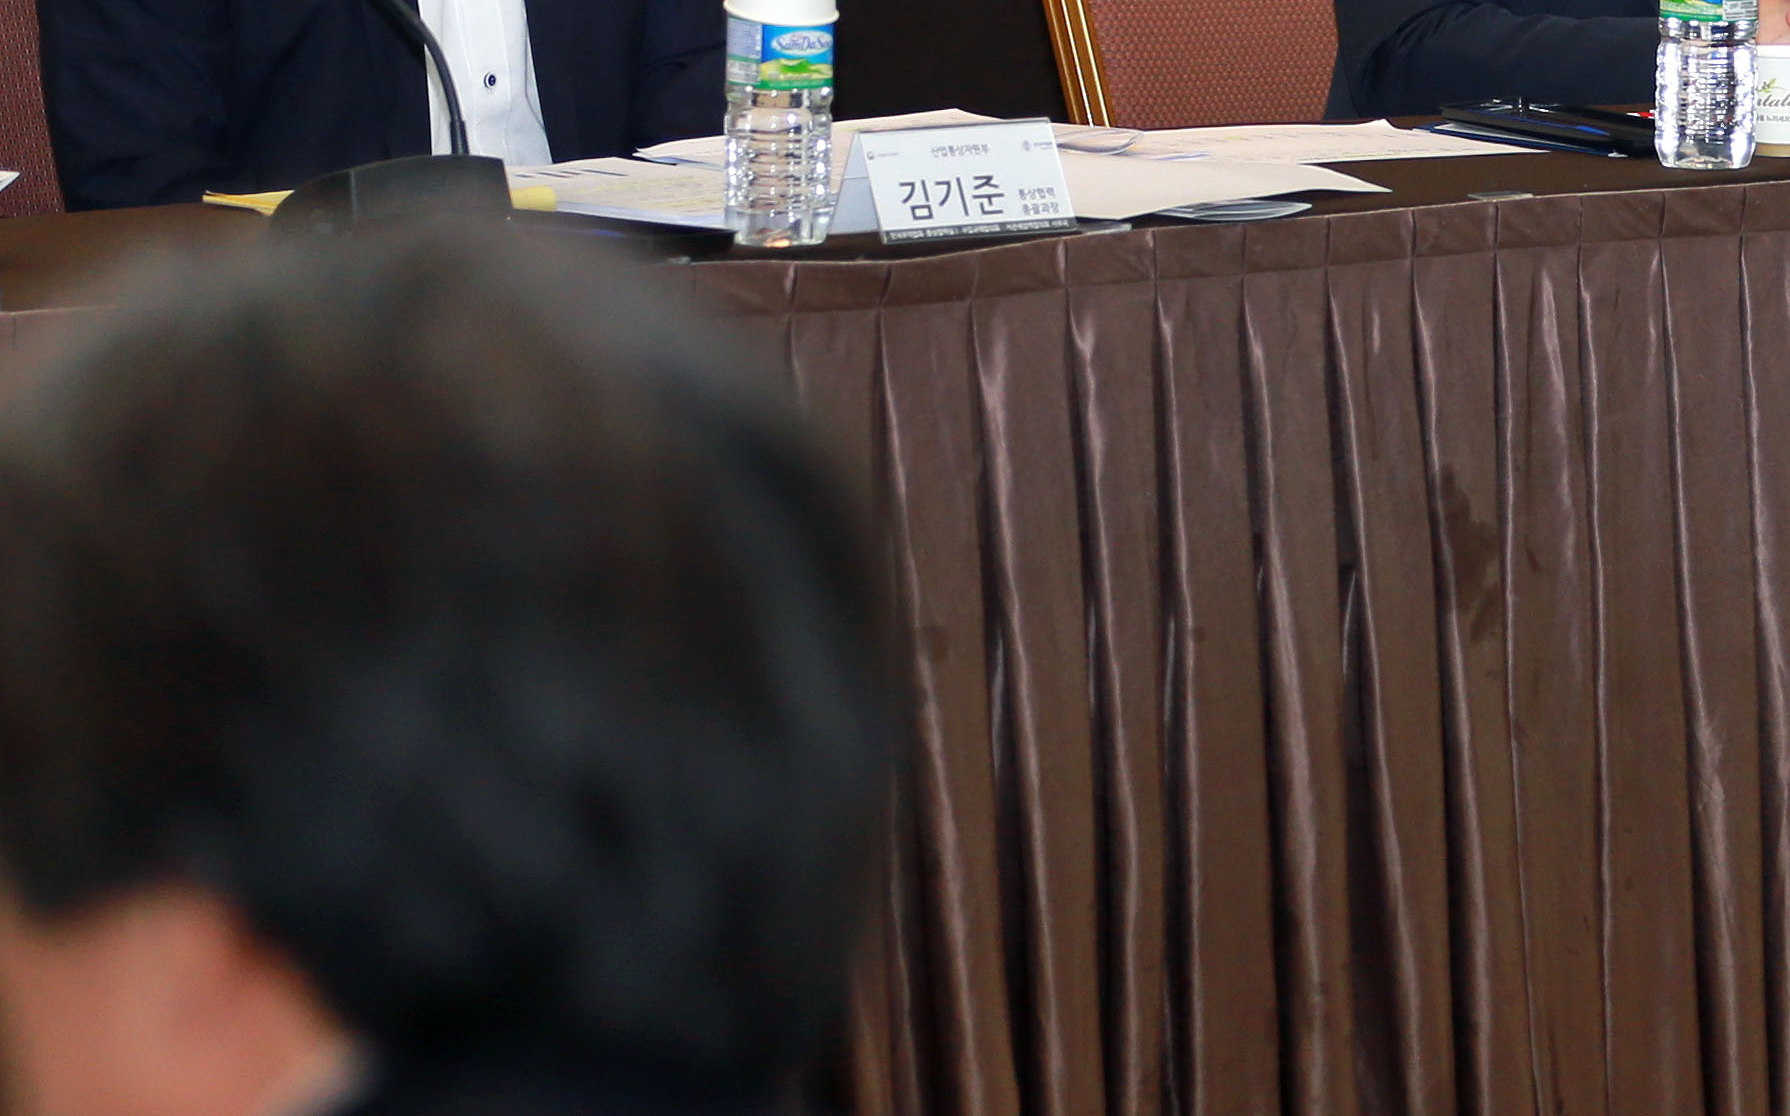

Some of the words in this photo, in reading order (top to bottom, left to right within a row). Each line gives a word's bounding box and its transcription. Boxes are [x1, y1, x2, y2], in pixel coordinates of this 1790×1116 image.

[930, 143, 990, 158] 산업통상자원부
[899, 174, 1005, 221] 김기준
[1018, 187, 1057, 201] 통상협력
